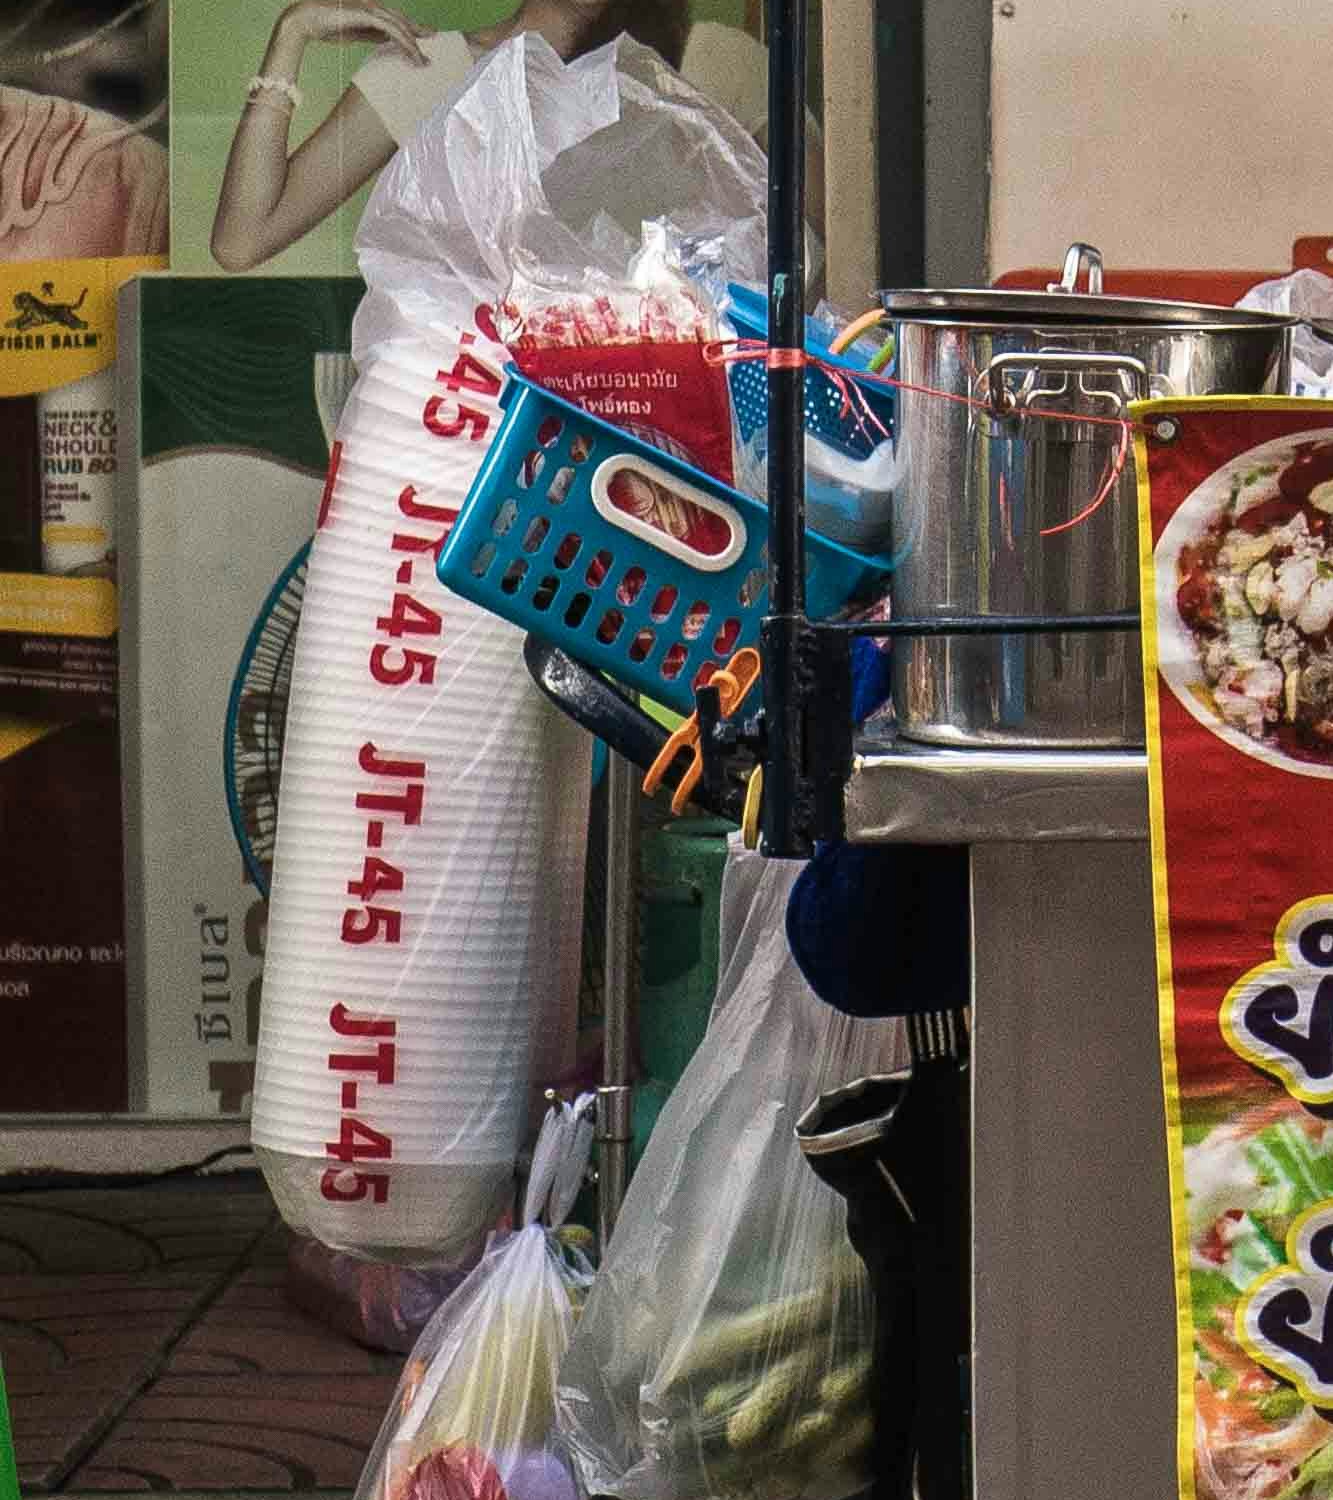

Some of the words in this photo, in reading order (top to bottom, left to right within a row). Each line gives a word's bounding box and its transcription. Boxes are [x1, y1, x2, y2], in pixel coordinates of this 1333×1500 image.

[44, 421, 97, 438] NECK
[44, 457, 84, 475] RUB
[340, 740, 427, 946] JT-45
[321, 1002, 396, 1205] JT-45
